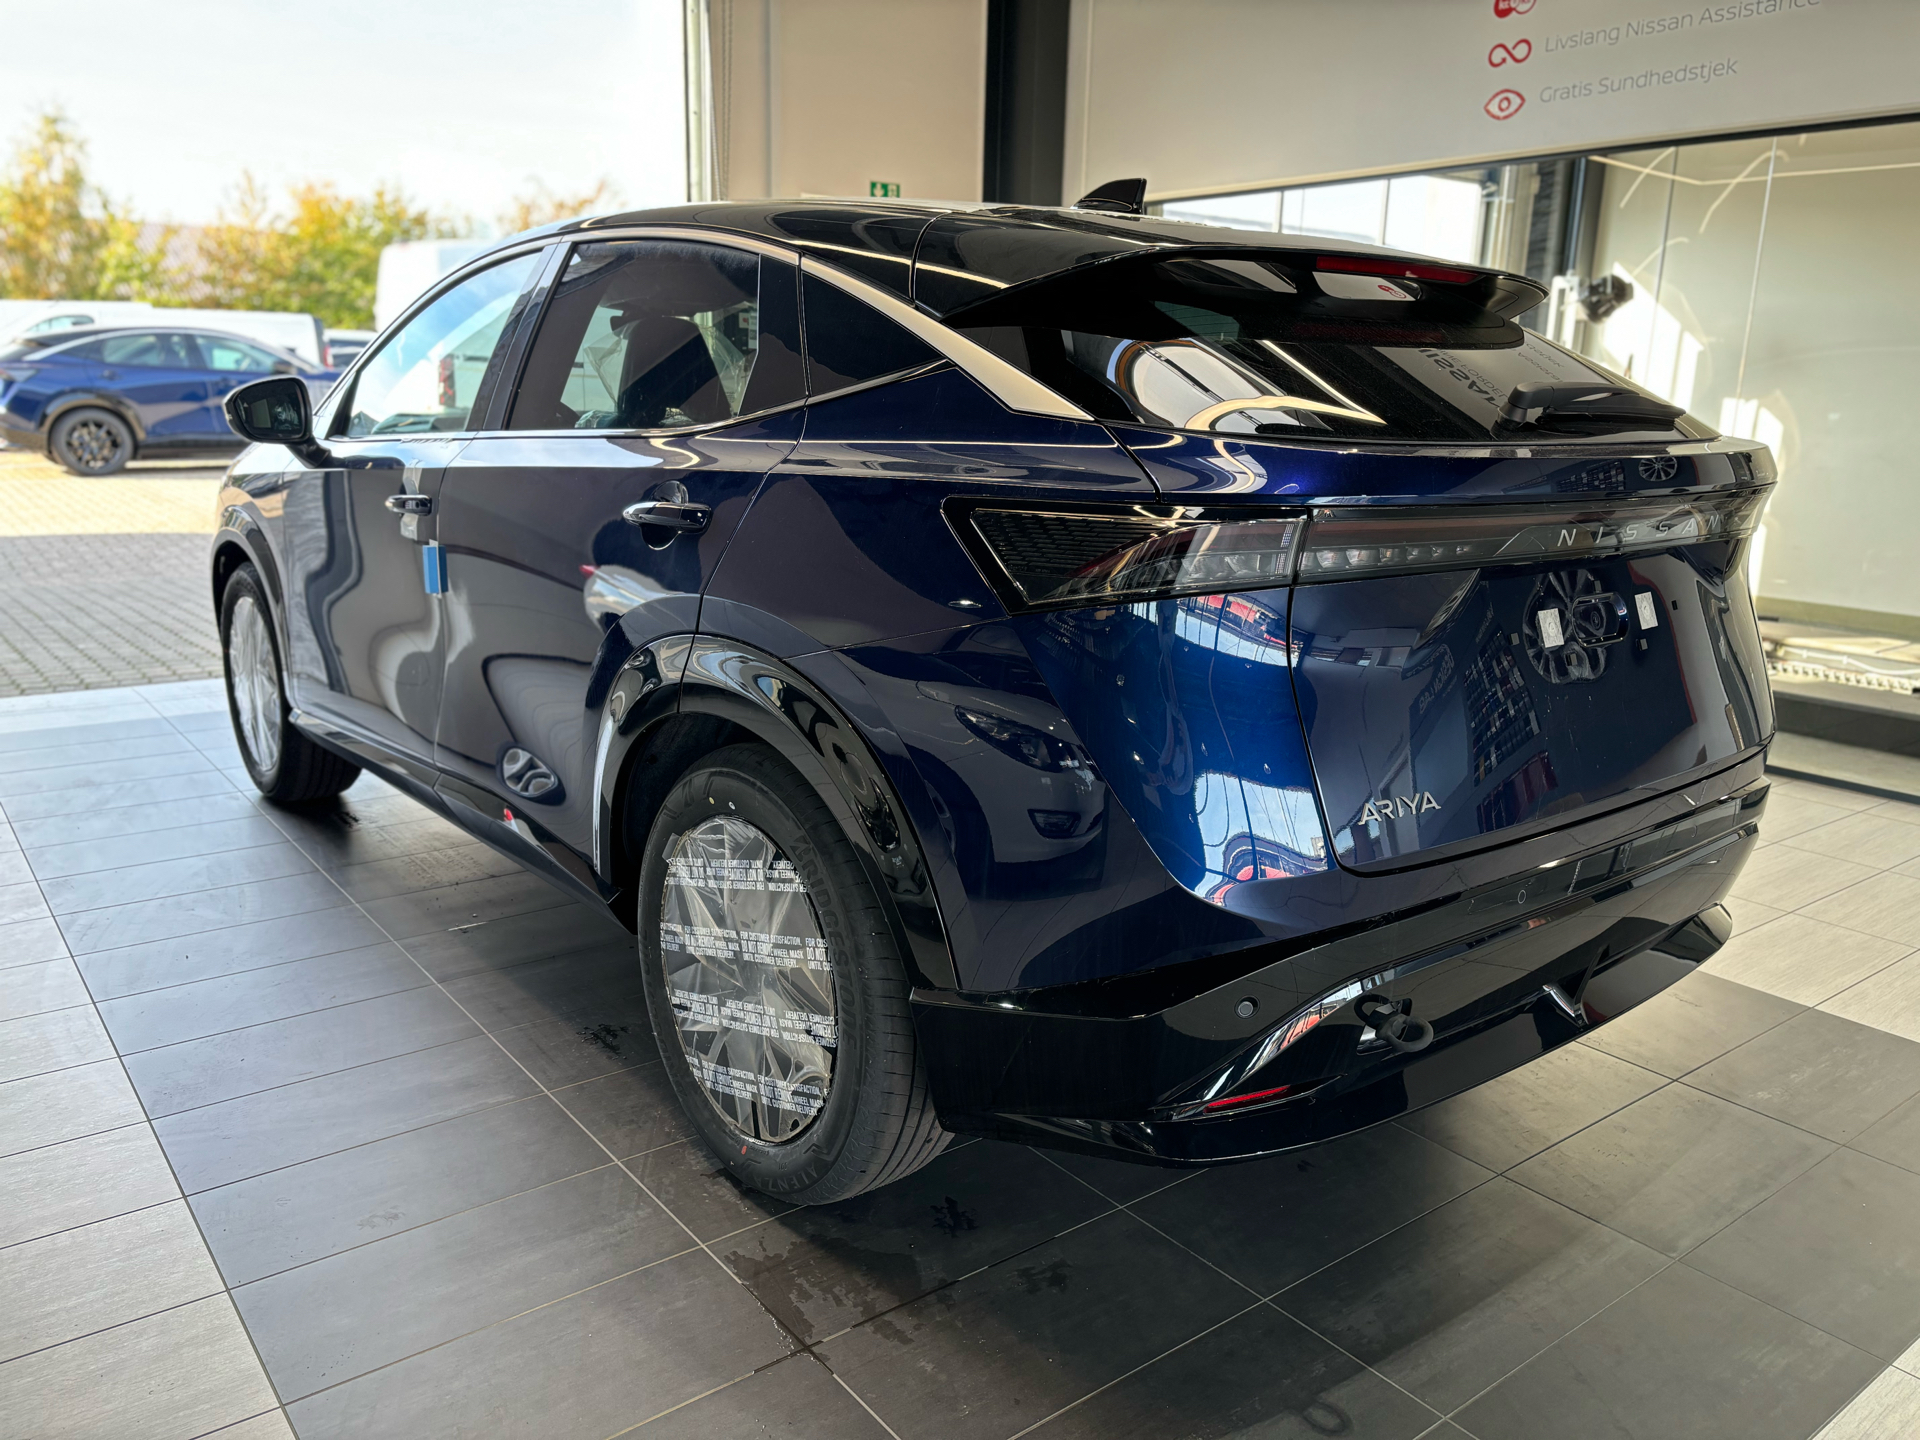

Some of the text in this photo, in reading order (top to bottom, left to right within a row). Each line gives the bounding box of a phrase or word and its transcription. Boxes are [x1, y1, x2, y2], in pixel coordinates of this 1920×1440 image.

[1544, 27, 1621, 53] Livslang
[1625, 15, 1694, 39] Nissan
[1539, 57, 1738, 103] Gratis Sundhedstjek
[1557, 514, 1719, 547] NISSAN
[1357, 791, 1442, 825] ARIYA
[733, 880, 755, 891] CUSTOMER
[756, 881, 765, 891] FOR
[740, 931, 749, 942] FOR
[749, 932, 770, 943] CUSTOMER
[789, 834, 858, 1052] BRIDGESTONE
[805, 937, 815, 947] FOR
[695, 947, 716, 957] CUSTOMER
[741, 939, 748, 953] DO
[748, 940, 757, 954] NOT
[757, 941, 773, 957] REMOVE
[789, 949, 804, 960] MASK
[806, 947, 826, 961] DO NOT
[742, 952, 755, 962] UNTIL
[755, 954, 775, 965] CUSTOMER
[807, 960, 822, 970] UNTIL
[743, 1002, 764, 1014] CUSTOMER
[744, 1010, 762, 1027] REMOVE
[761, 1014, 771, 1028] NOT
[769, 1015, 778, 1029] DO
[809, 1013, 835, 1025] CUSTOMER
[749, 1025, 771, 1038] CUSTOMER
[770, 1029, 780, 1039] FOR
[752, 1161, 819, 1192] ALENZA
